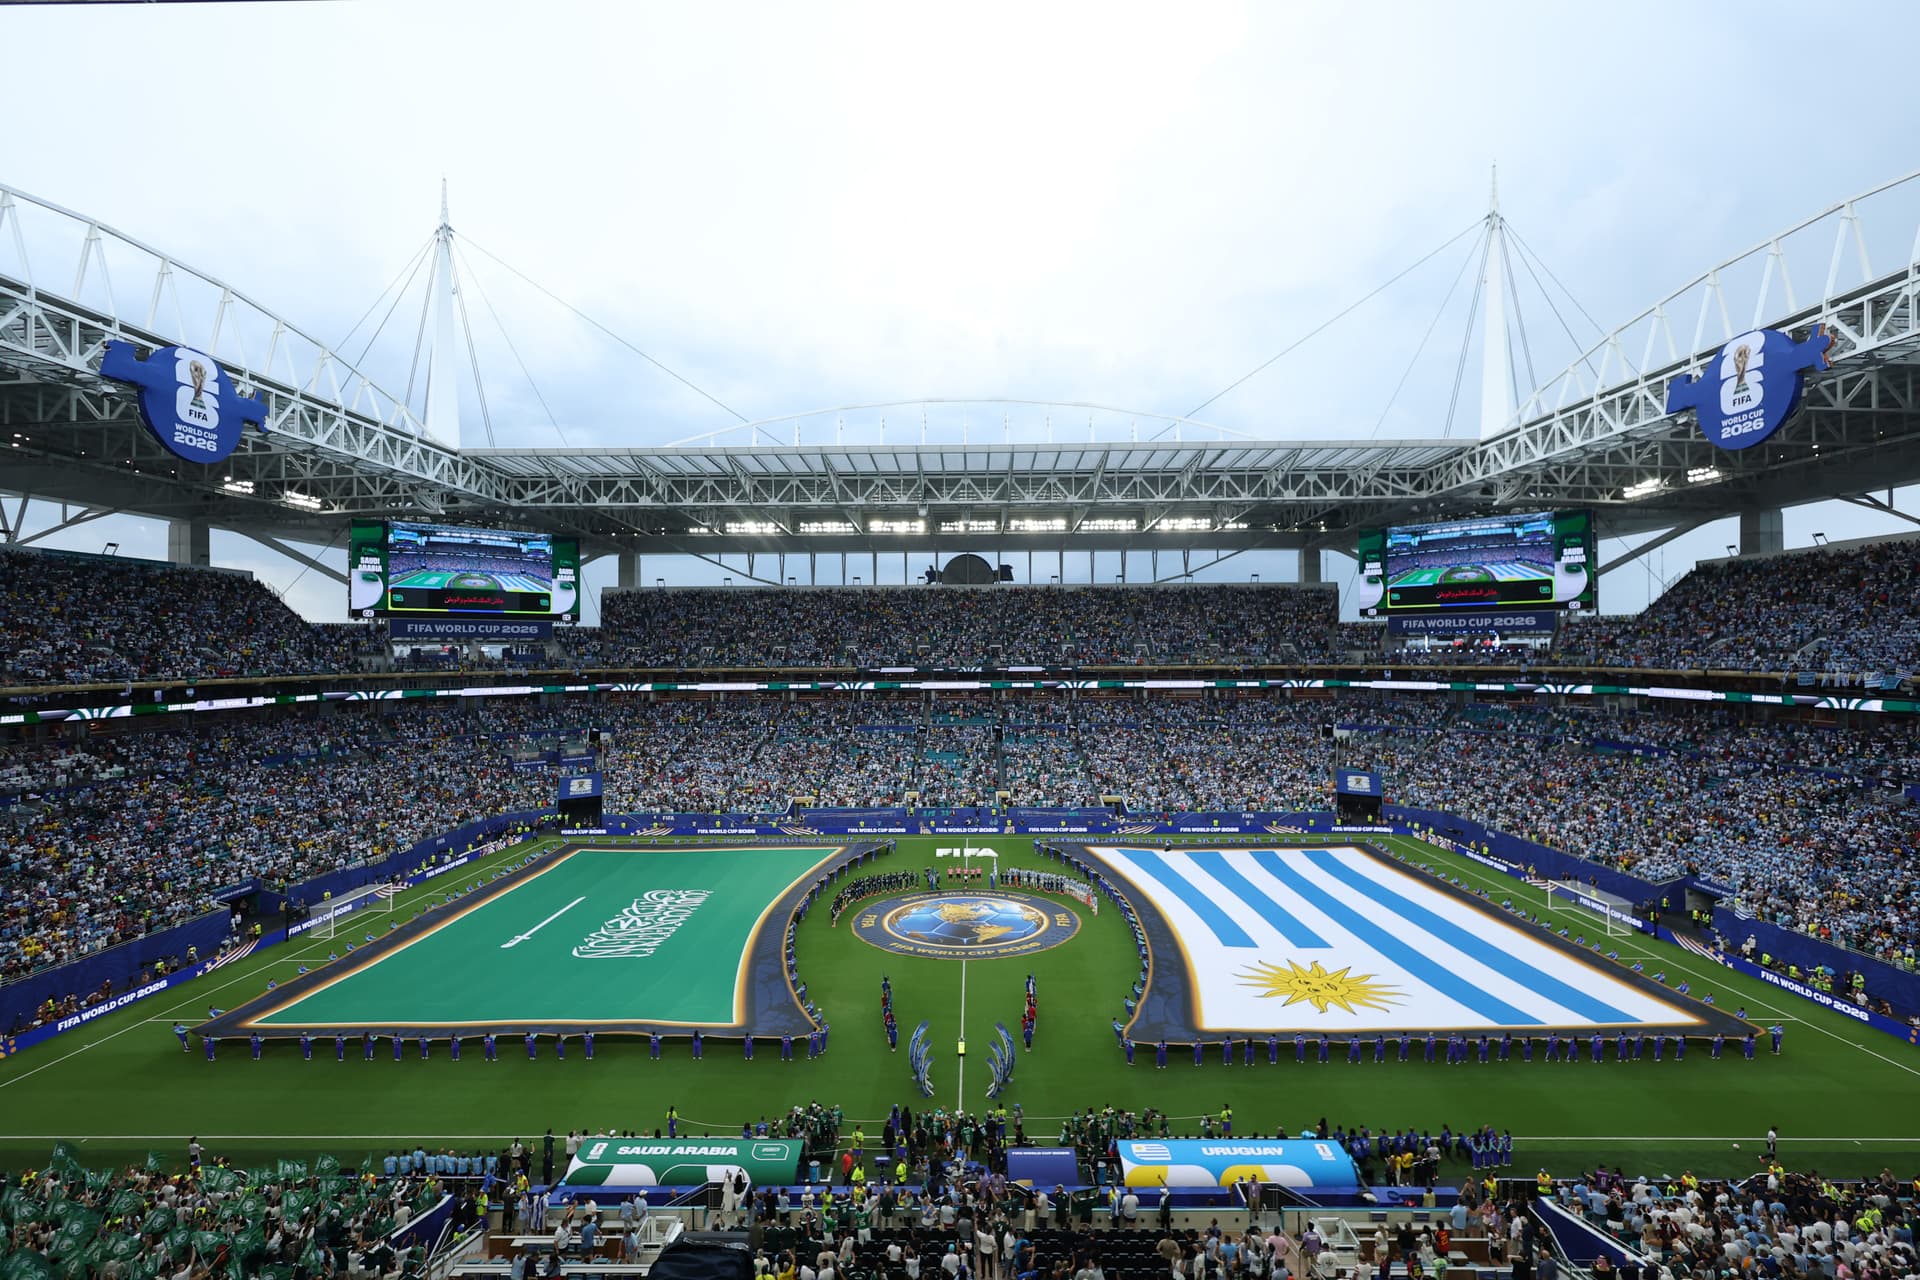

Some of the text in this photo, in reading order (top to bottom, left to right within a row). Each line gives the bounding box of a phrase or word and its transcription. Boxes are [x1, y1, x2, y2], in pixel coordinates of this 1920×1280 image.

[1732, 396, 1752, 406] FIFA
[188, 409, 208, 422] FIFA
[1721, 409, 1764, 427] WORLD CUP
[175, 423, 218, 440] WORLD CUP
[1720, 418, 1765, 440] 2026
[174, 432, 217, 452] 2026
[407, 624, 538, 634] FIFA WORLD CUP 2026
[1402, 616, 1536, 628] FIFA WORLD CUP 2026
[936, 848, 998, 857] FIFA
[288, 925, 301, 935] FIFA
[302, 916, 322, 930] WORLD
[334, 904, 352, 916] 2026
[1580, 897, 1590, 907] FIFA
[1610, 910, 1622, 919] CUP
[1622, 914, 1643, 928] 2026
[861, 914, 878, 928] FIFA
[1054, 913, 1072, 927] FIFA
[890, 942, 914, 951] FIFA
[997, 942, 1041, 953] 2026
[1761, 971, 1870, 1021] FIFA WORLD CUP 2026
[58, 980, 168, 1031] FIFA WORLD CUP 2026
[617, 1146, 738, 1156] SAUDI ARABIA
[1201, 1147, 1283, 1156] URUGUAY
